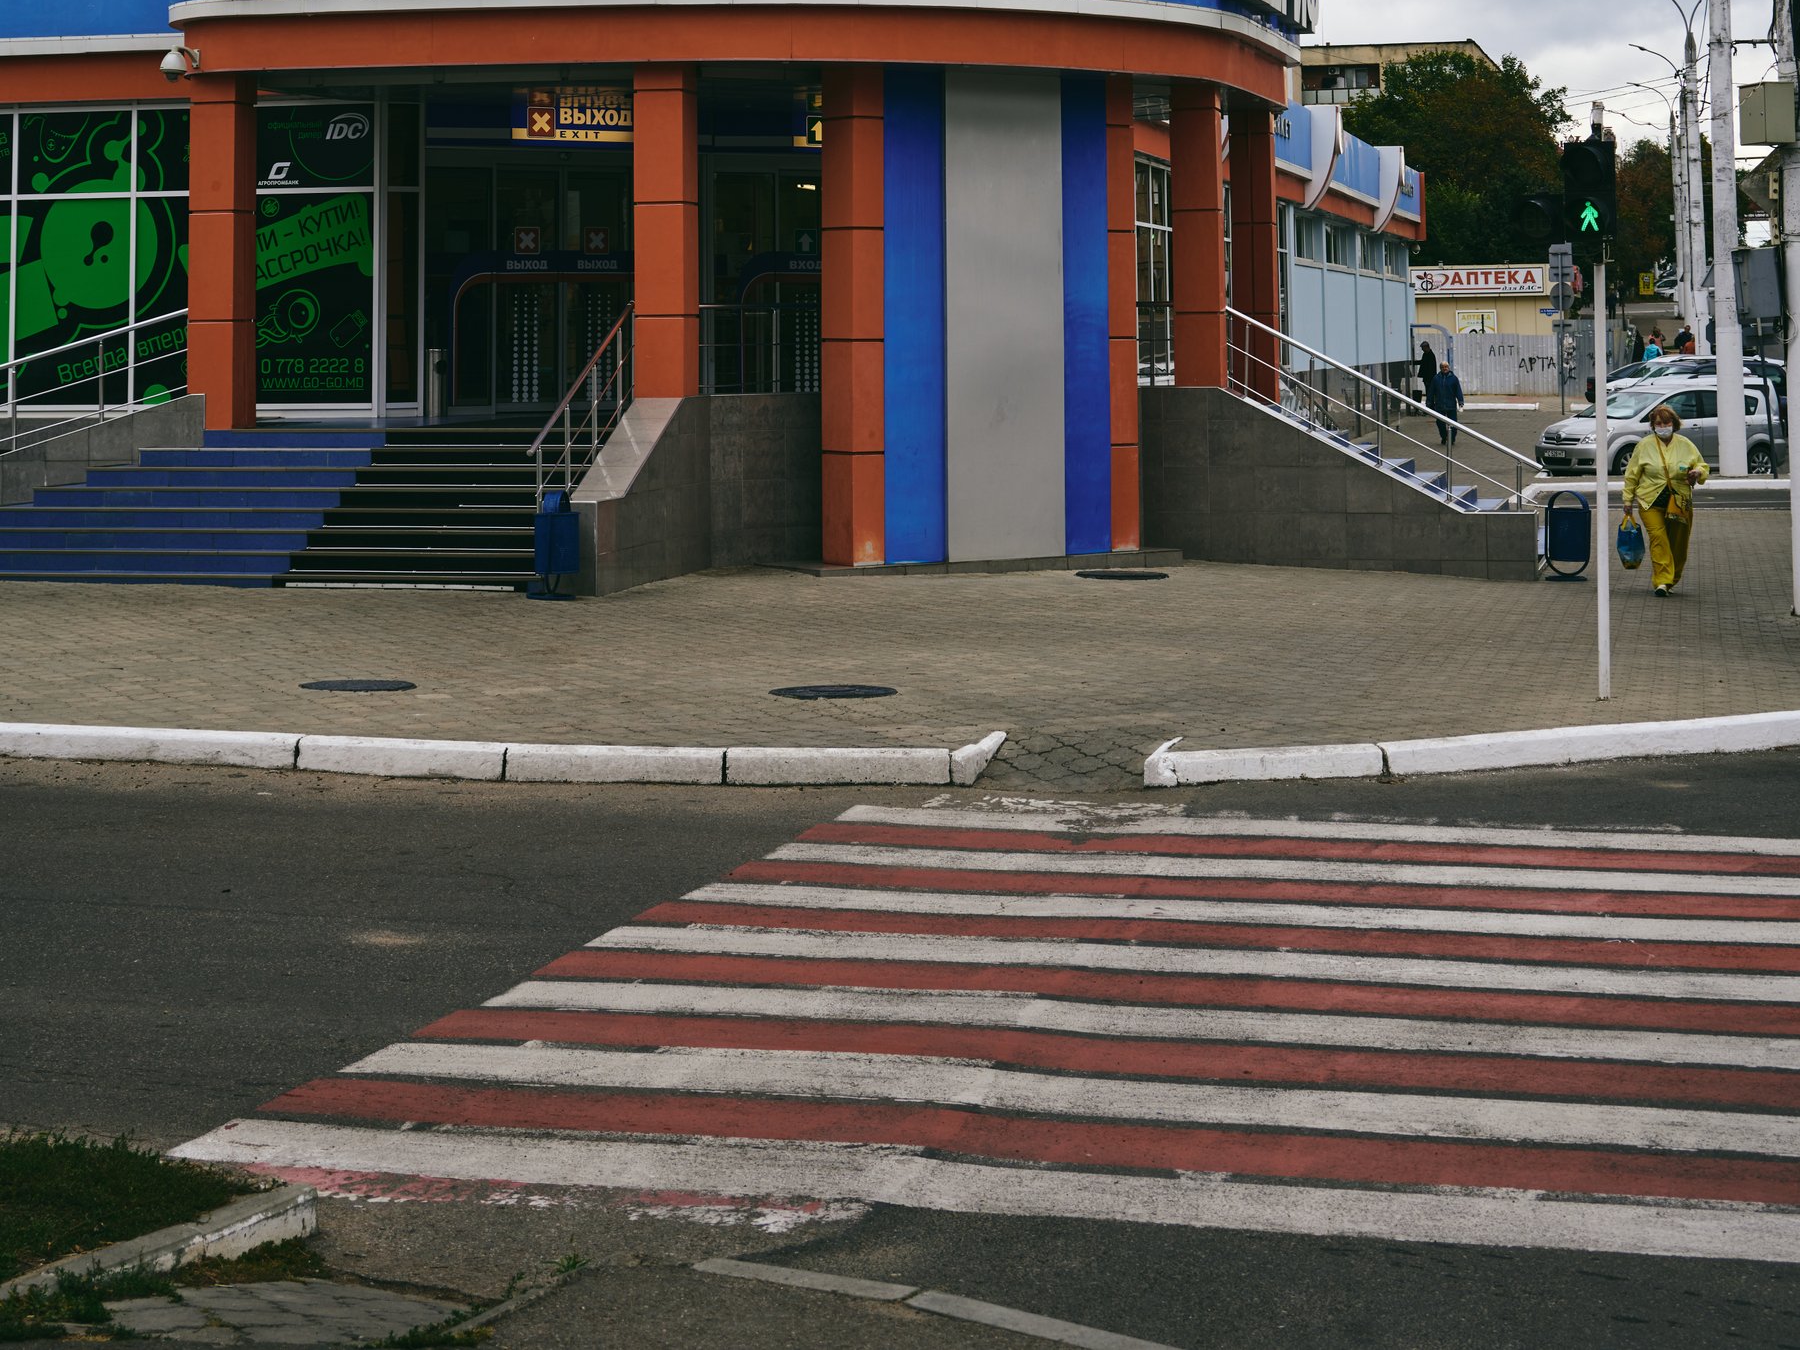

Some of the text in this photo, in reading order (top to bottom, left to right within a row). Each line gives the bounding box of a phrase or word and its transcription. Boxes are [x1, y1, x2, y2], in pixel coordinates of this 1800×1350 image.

[559, 107, 633, 126] ВЫХОД
[325, 122, 364, 140] IDC
[560, 131, 600, 139] EXIT
[297, 200, 361, 238] КУПИ!
[256, 228, 366, 282] АССРОЧКА!
[506, 259, 548, 270] ВЫХОД
[577, 259, 618, 270] ВЫХОД
[1450, 270, 1536, 286] АПТЕКА
[136, 326, 187, 358] впер
[260, 358, 365, 374] 0 778 2222 8
[261, 377, 364, 389] WWW.GO-GO.MD
